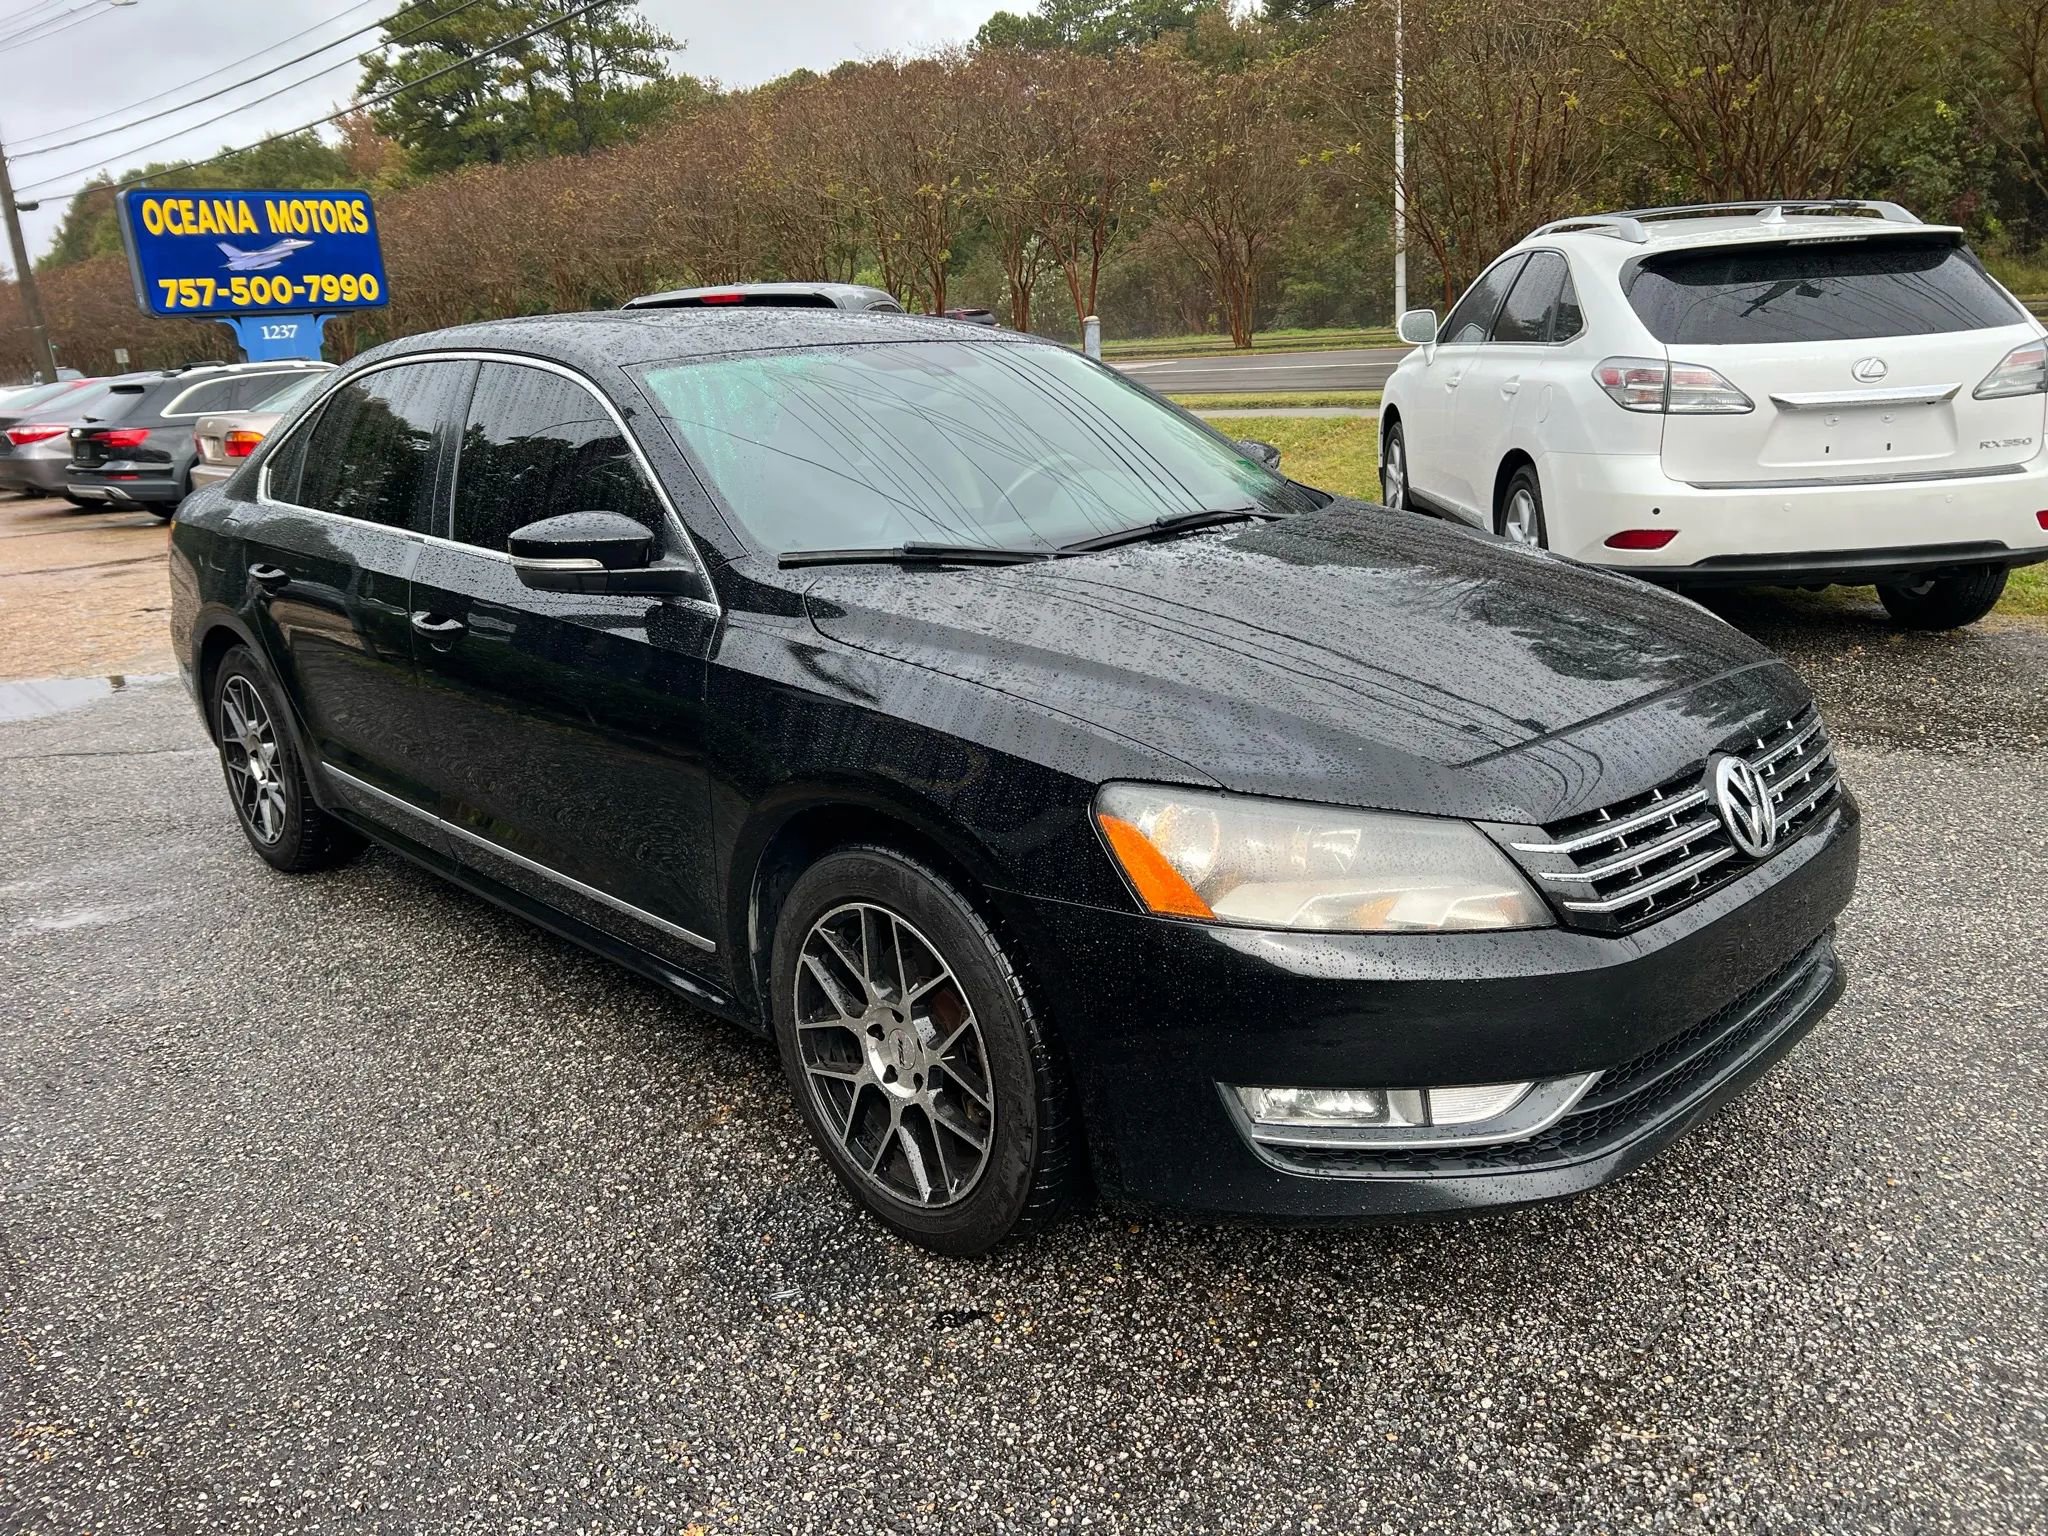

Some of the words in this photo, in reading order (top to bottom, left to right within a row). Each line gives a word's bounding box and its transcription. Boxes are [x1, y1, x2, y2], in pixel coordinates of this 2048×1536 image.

[141, 198, 259, 236] OCEANA
[265, 199, 369, 234] MOTORS
[158, 273, 380, 308] 757-500-7990
[260, 324, 299, 340] 1237
